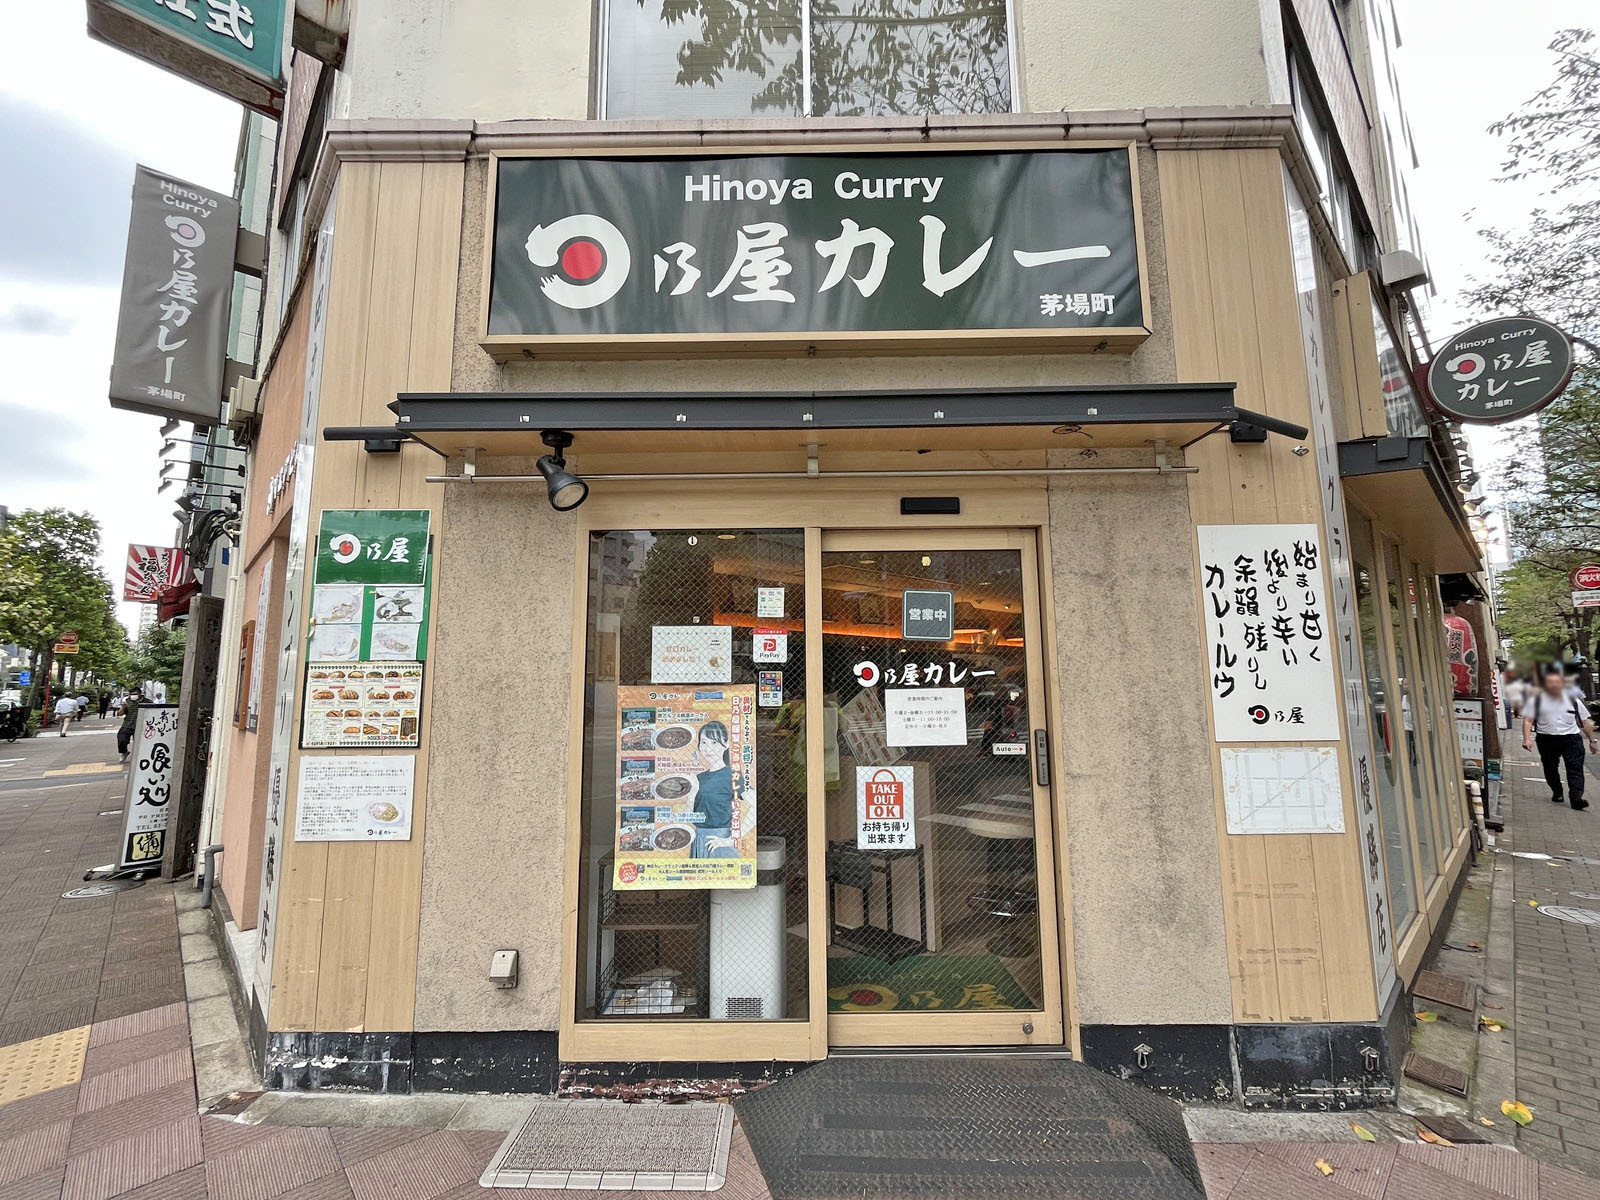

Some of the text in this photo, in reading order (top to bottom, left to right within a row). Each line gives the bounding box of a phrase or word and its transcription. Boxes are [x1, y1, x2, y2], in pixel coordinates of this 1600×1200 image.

[160, 179, 218, 208] Hinoya
[684, 172, 944, 205] Hinoya Curry
[162, 193, 211, 218] Curry
[1040, 293, 1116, 316] 茅場町
[1455, 328, 1537, 351] Hinoya Curry
[1457, 377, 1540, 401] カレー
[1264, 548, 1298, 666] 後より辛い
[1293, 540, 1322, 662] 始まり甘く
[908, 607, 947, 622] 営業中
[1205, 563, 1238, 699] カレールウ
[871, 784, 898, 793] TAKE
[874, 795, 895, 804] OUT
[874, 806, 896, 817] OK
[862, 822, 909, 832] お持ち帰り
[868, 834, 906, 844] 出来ます
